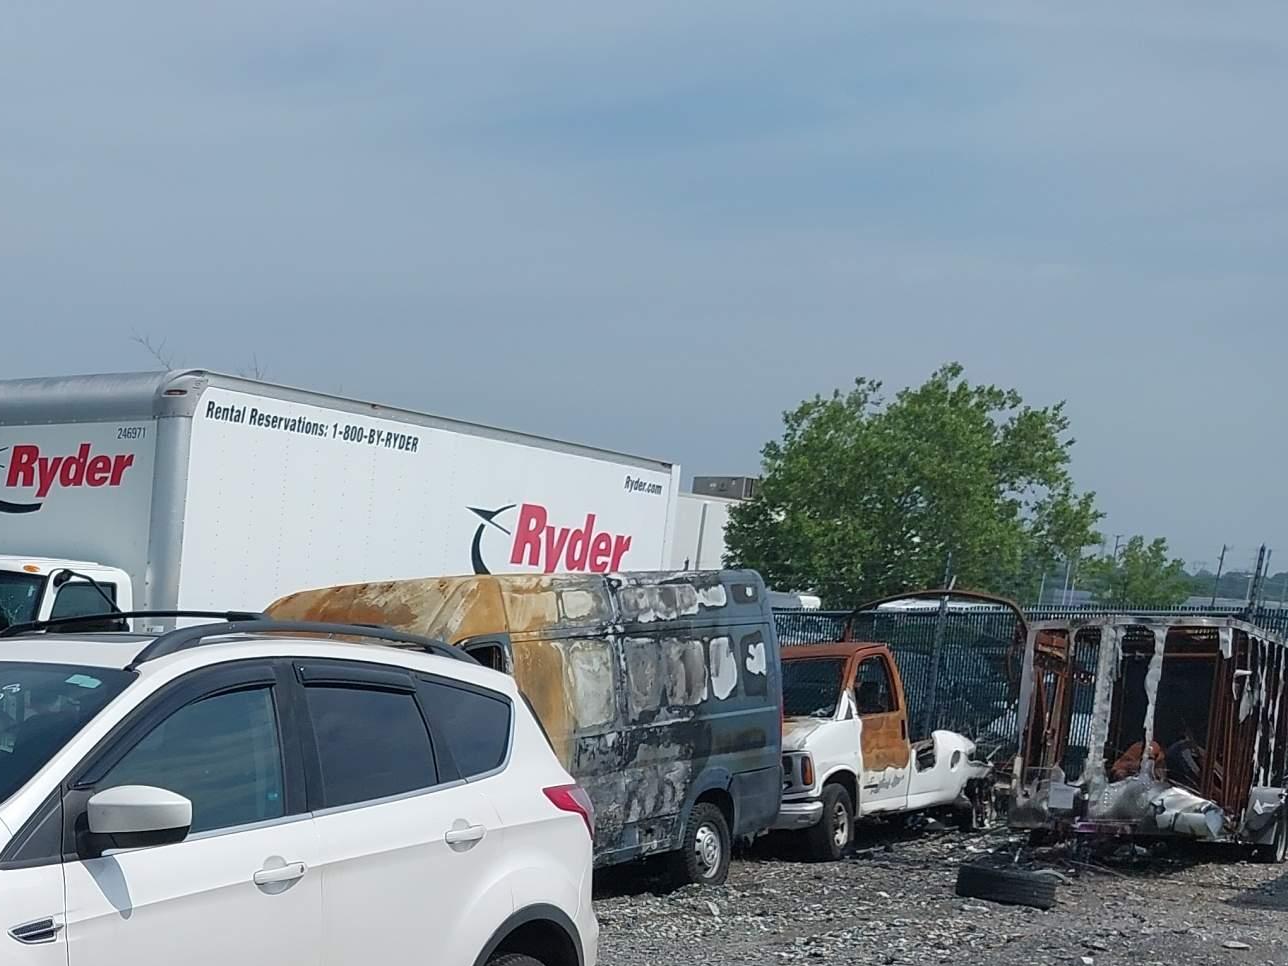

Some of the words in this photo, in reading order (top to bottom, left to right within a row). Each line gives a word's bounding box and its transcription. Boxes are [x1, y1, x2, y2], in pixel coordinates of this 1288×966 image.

[117, 427, 146, 440] 246971
[205, 401, 246, 424] Rental
[249, 407, 329, 438] Reservations:
[332, 422, 420, 453] 1-800-BY-RYDER
[6, 443, 135, 498] Ryder
[624, 475, 662, 496] Ryder.com
[509, 503, 632, 574] Ryder
